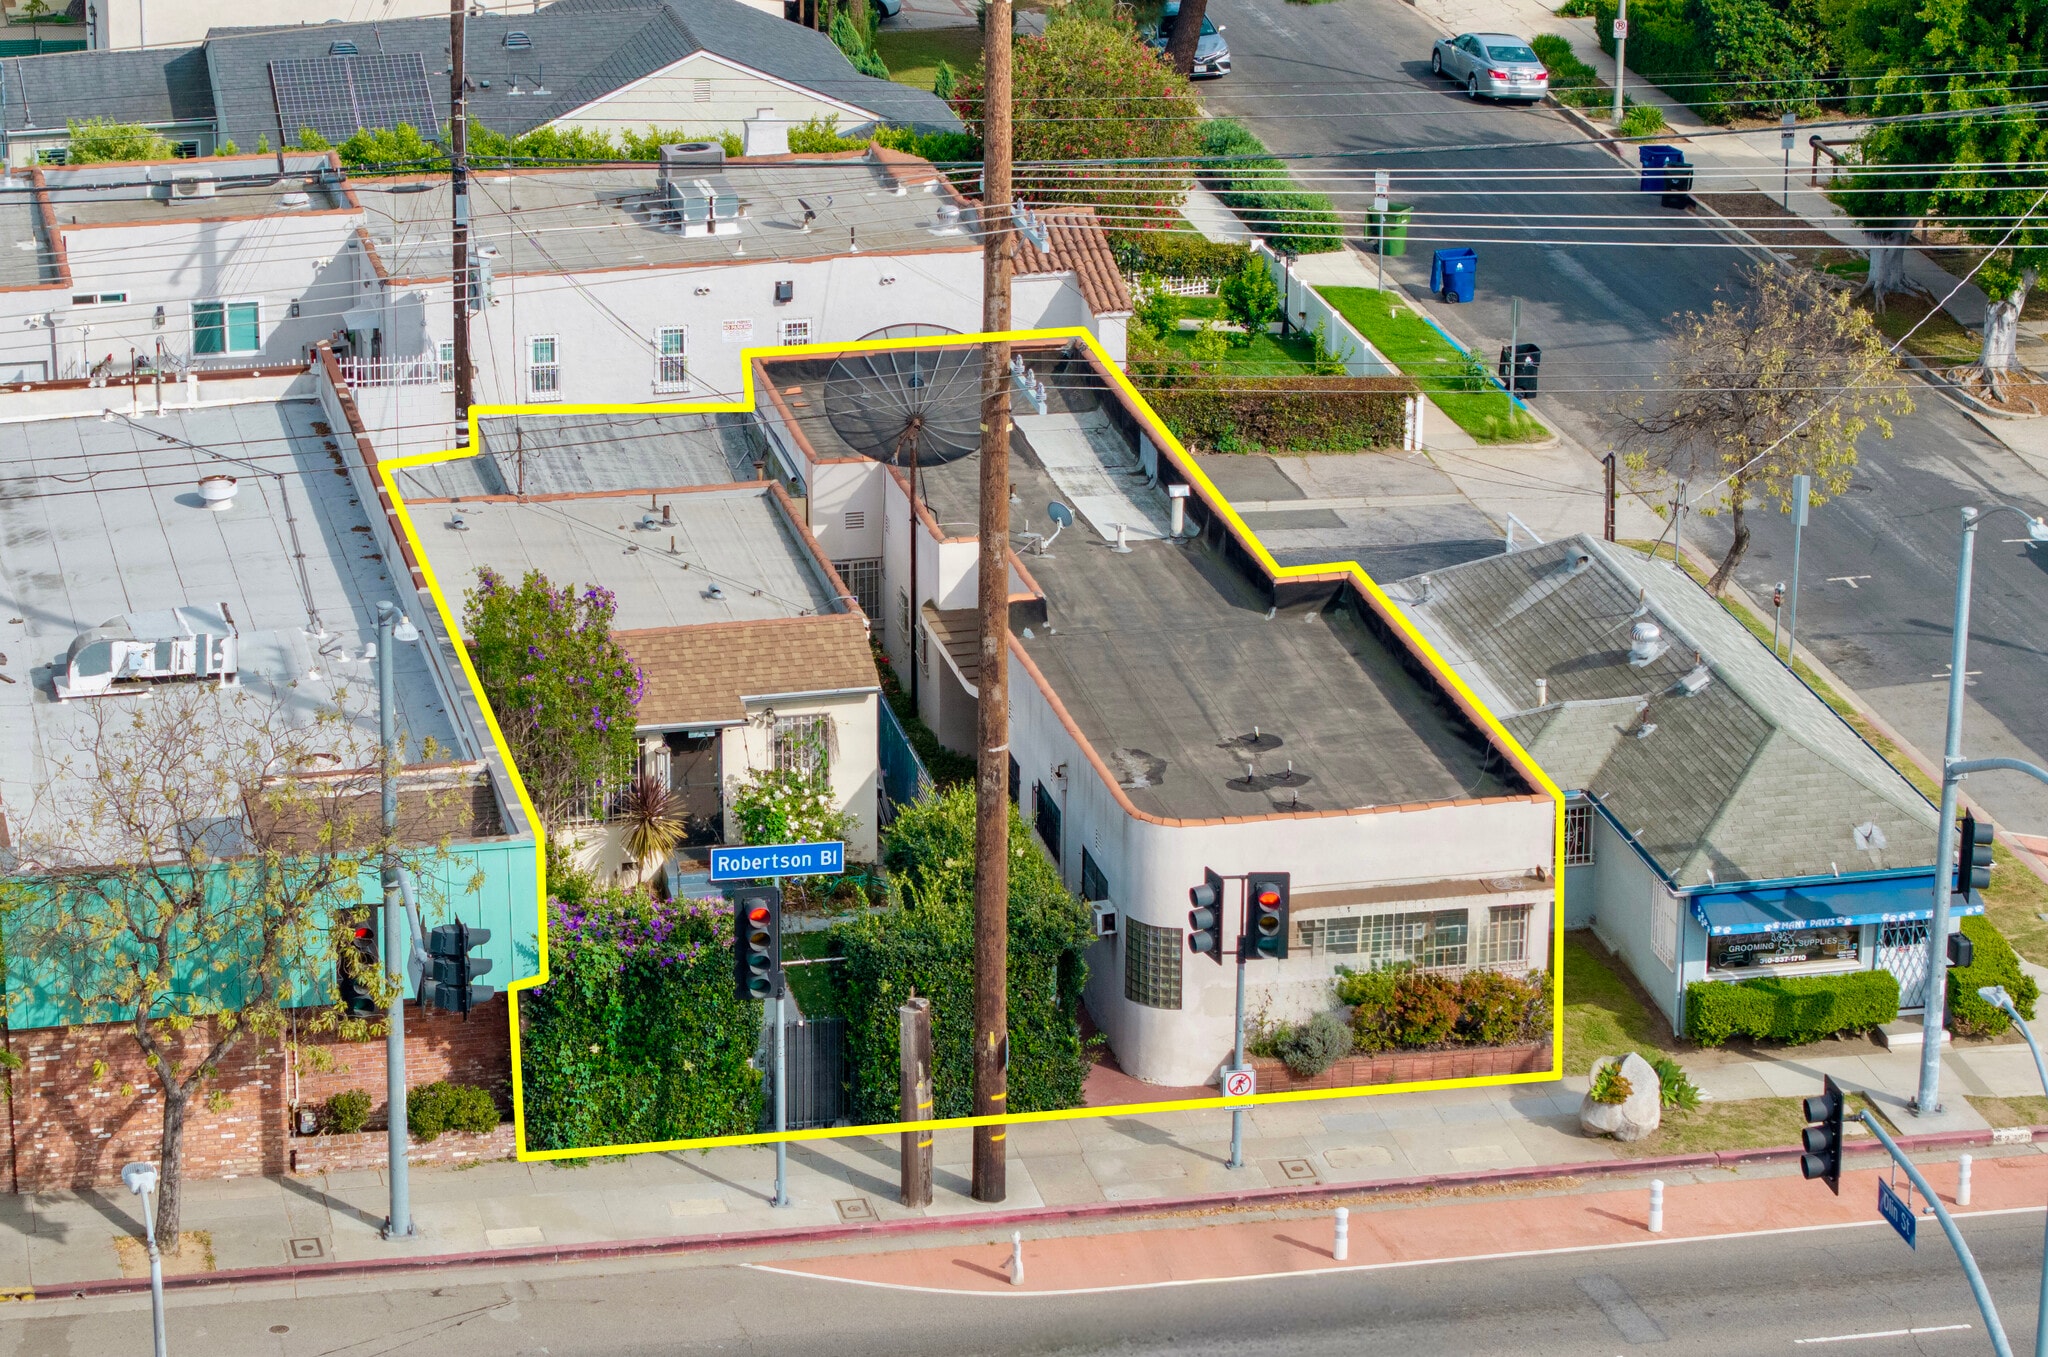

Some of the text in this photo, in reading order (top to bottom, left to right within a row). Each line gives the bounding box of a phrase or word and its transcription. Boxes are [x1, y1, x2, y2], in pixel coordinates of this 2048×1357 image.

[718, 853, 812, 872] Robertson
[1781, 917, 1836, 930] MANY PAWS
[1728, 937, 1838, 953] GROOMING SUPPLIES
[1883, 1192, 1910, 1235] Olin St
